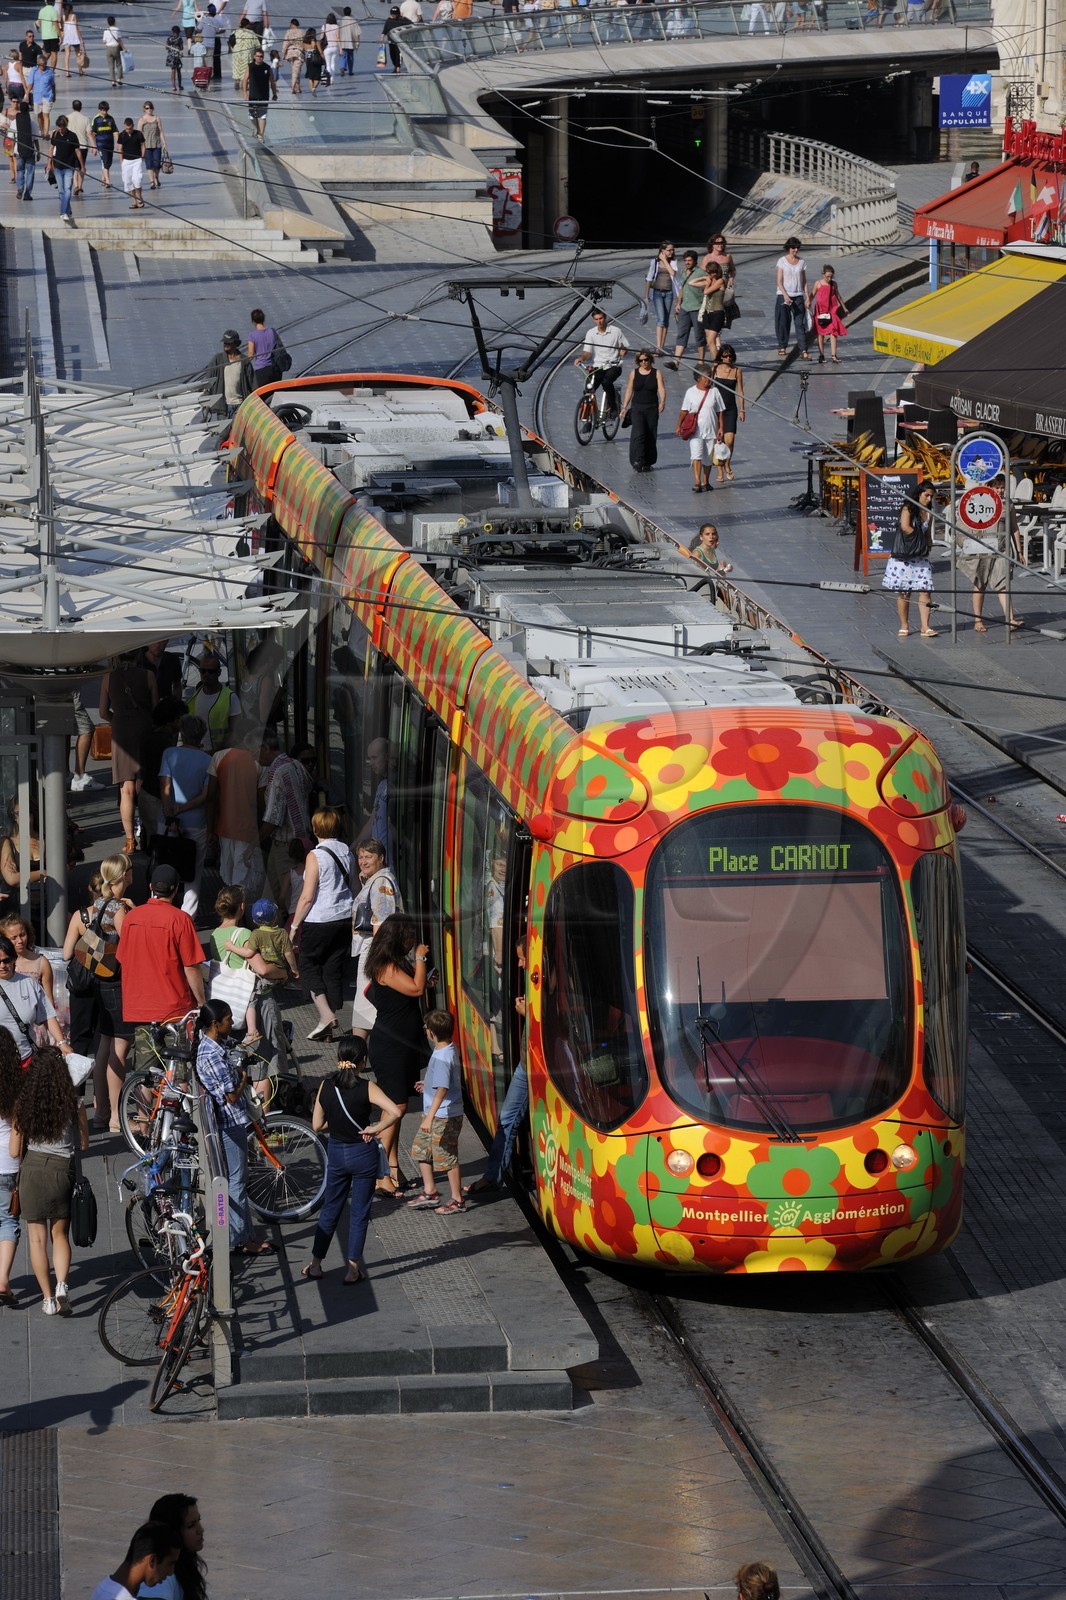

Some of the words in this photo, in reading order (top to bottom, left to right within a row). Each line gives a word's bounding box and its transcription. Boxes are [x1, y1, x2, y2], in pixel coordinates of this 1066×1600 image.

[949, 395, 972, 416] ARTISAN
[975, 401, 1000, 422] GLACIER
[1035, 413, 1066, 435] BRASSERI
[968, 502, 994, 515] 3,3m
[709, 847, 759, 872] Place
[770, 845, 851, 871] CARNOT
[559, 1155, 592, 1189] Montpellier
[560, 1177, 595, 1208] Agglomération
[682, 1207, 769, 1224] Montpellier
[802, 1203, 905, 1224] Agglomération
